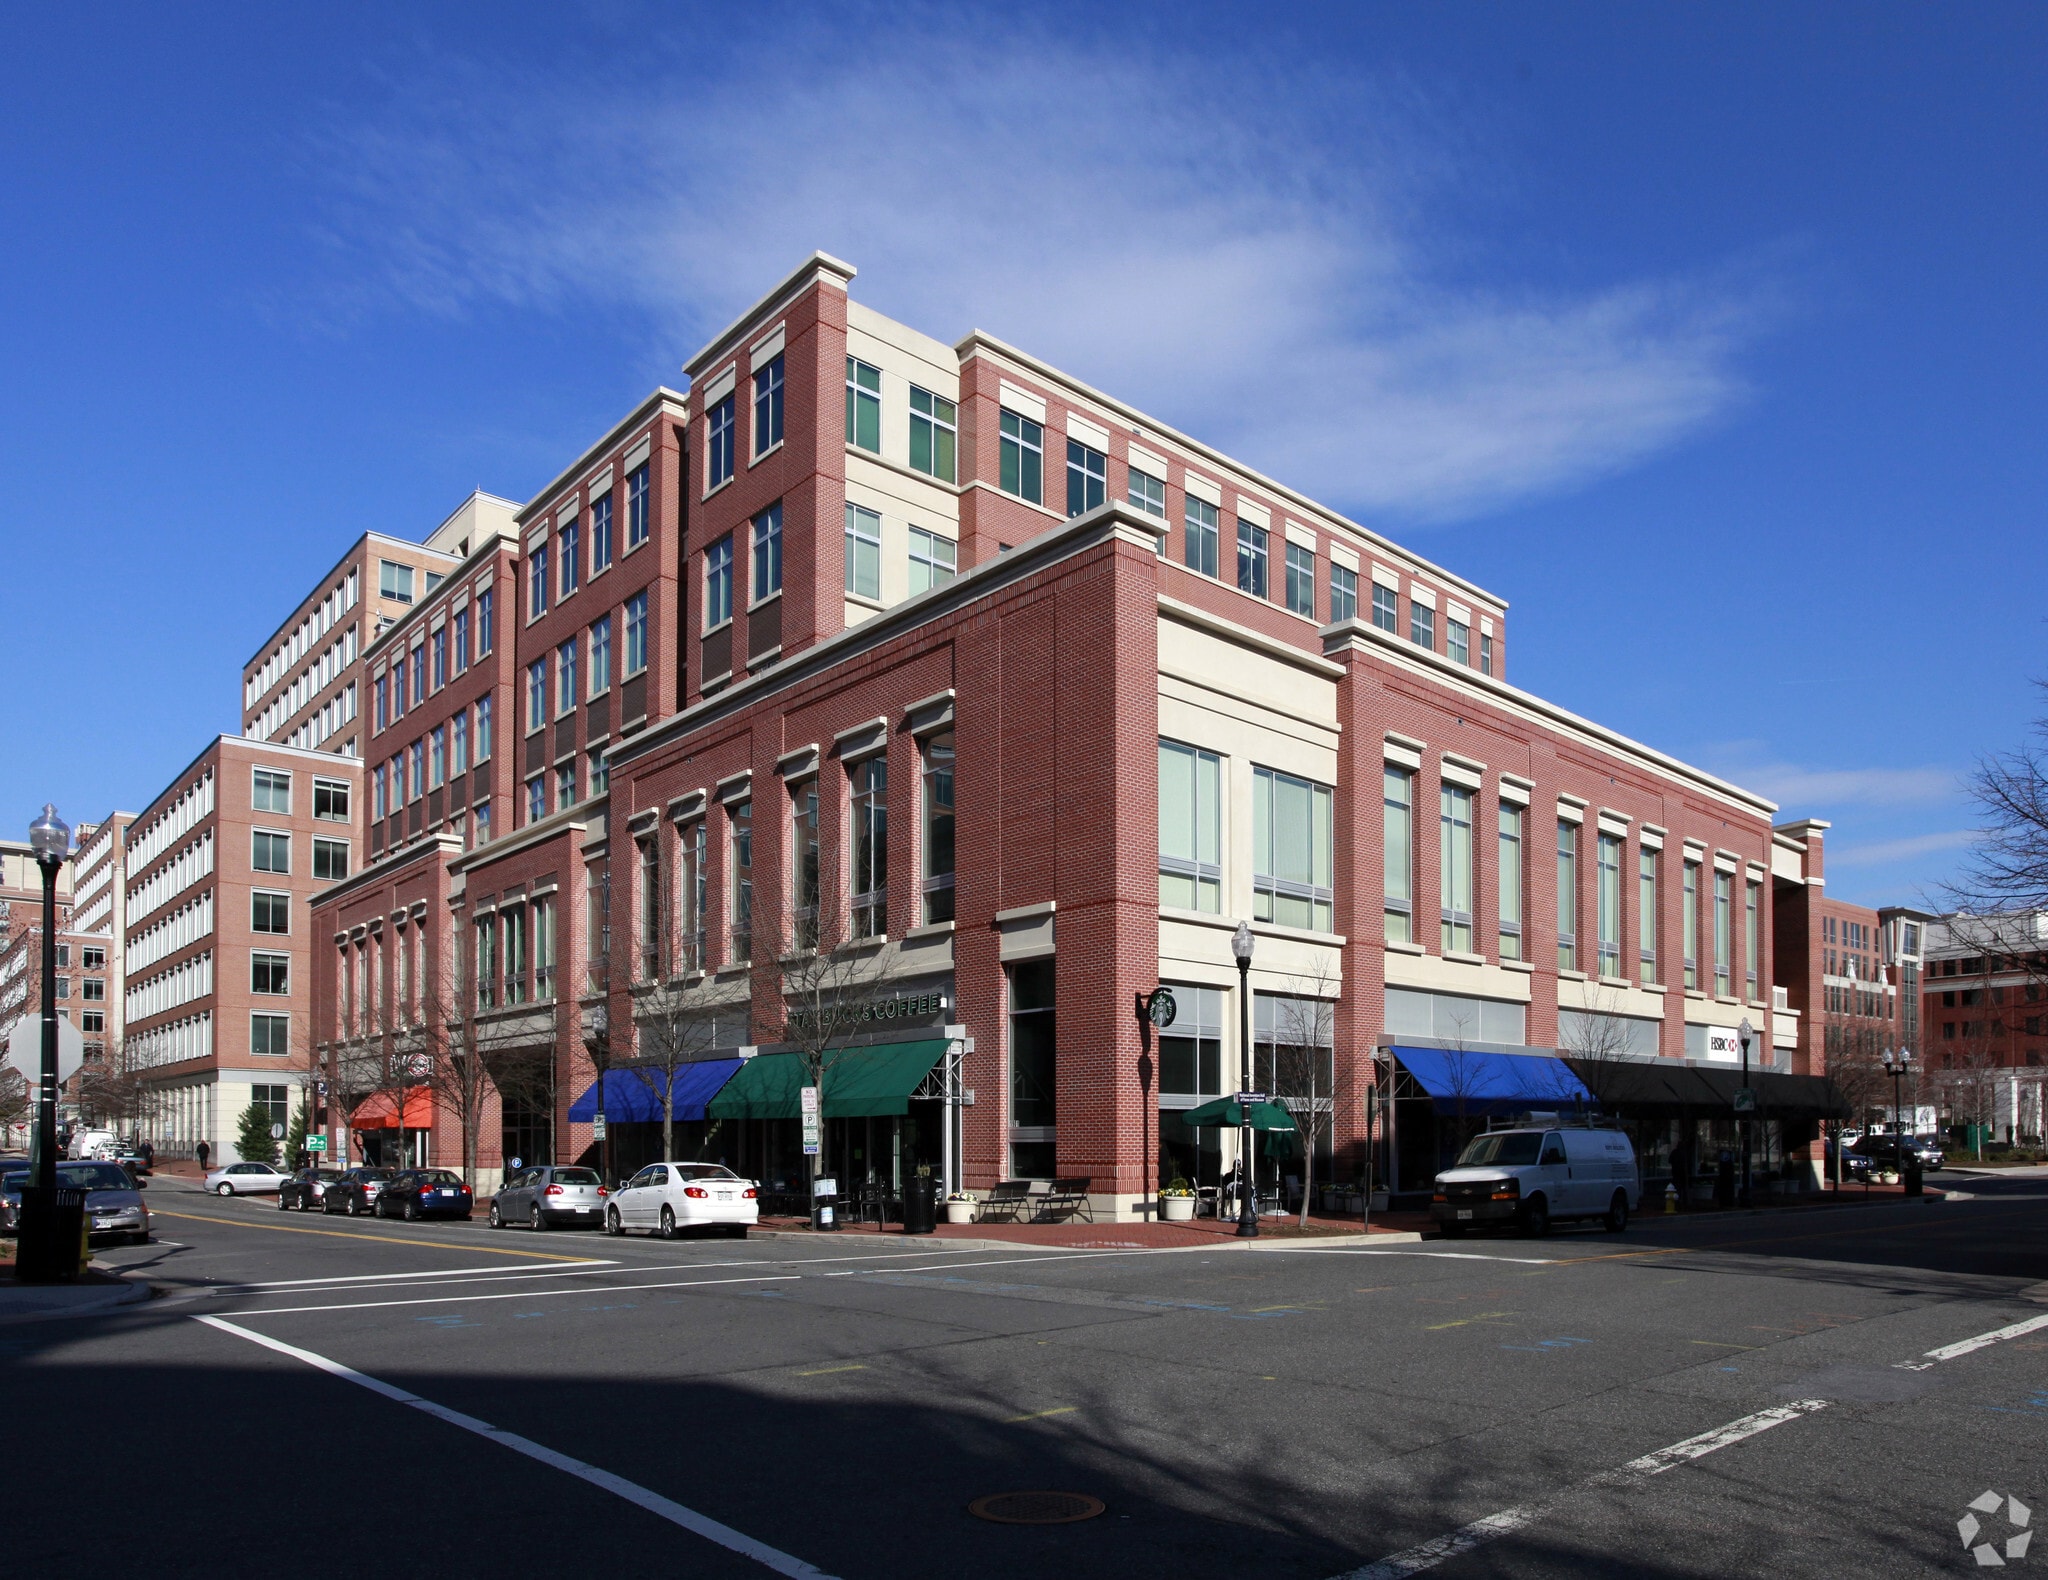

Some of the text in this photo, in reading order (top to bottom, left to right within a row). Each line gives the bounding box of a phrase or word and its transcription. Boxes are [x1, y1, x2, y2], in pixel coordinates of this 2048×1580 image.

[875, 993, 940, 1019] COFFEE
[1711, 1037, 1728, 1051] HSBC
[307, 1137, 317, 1149] P
